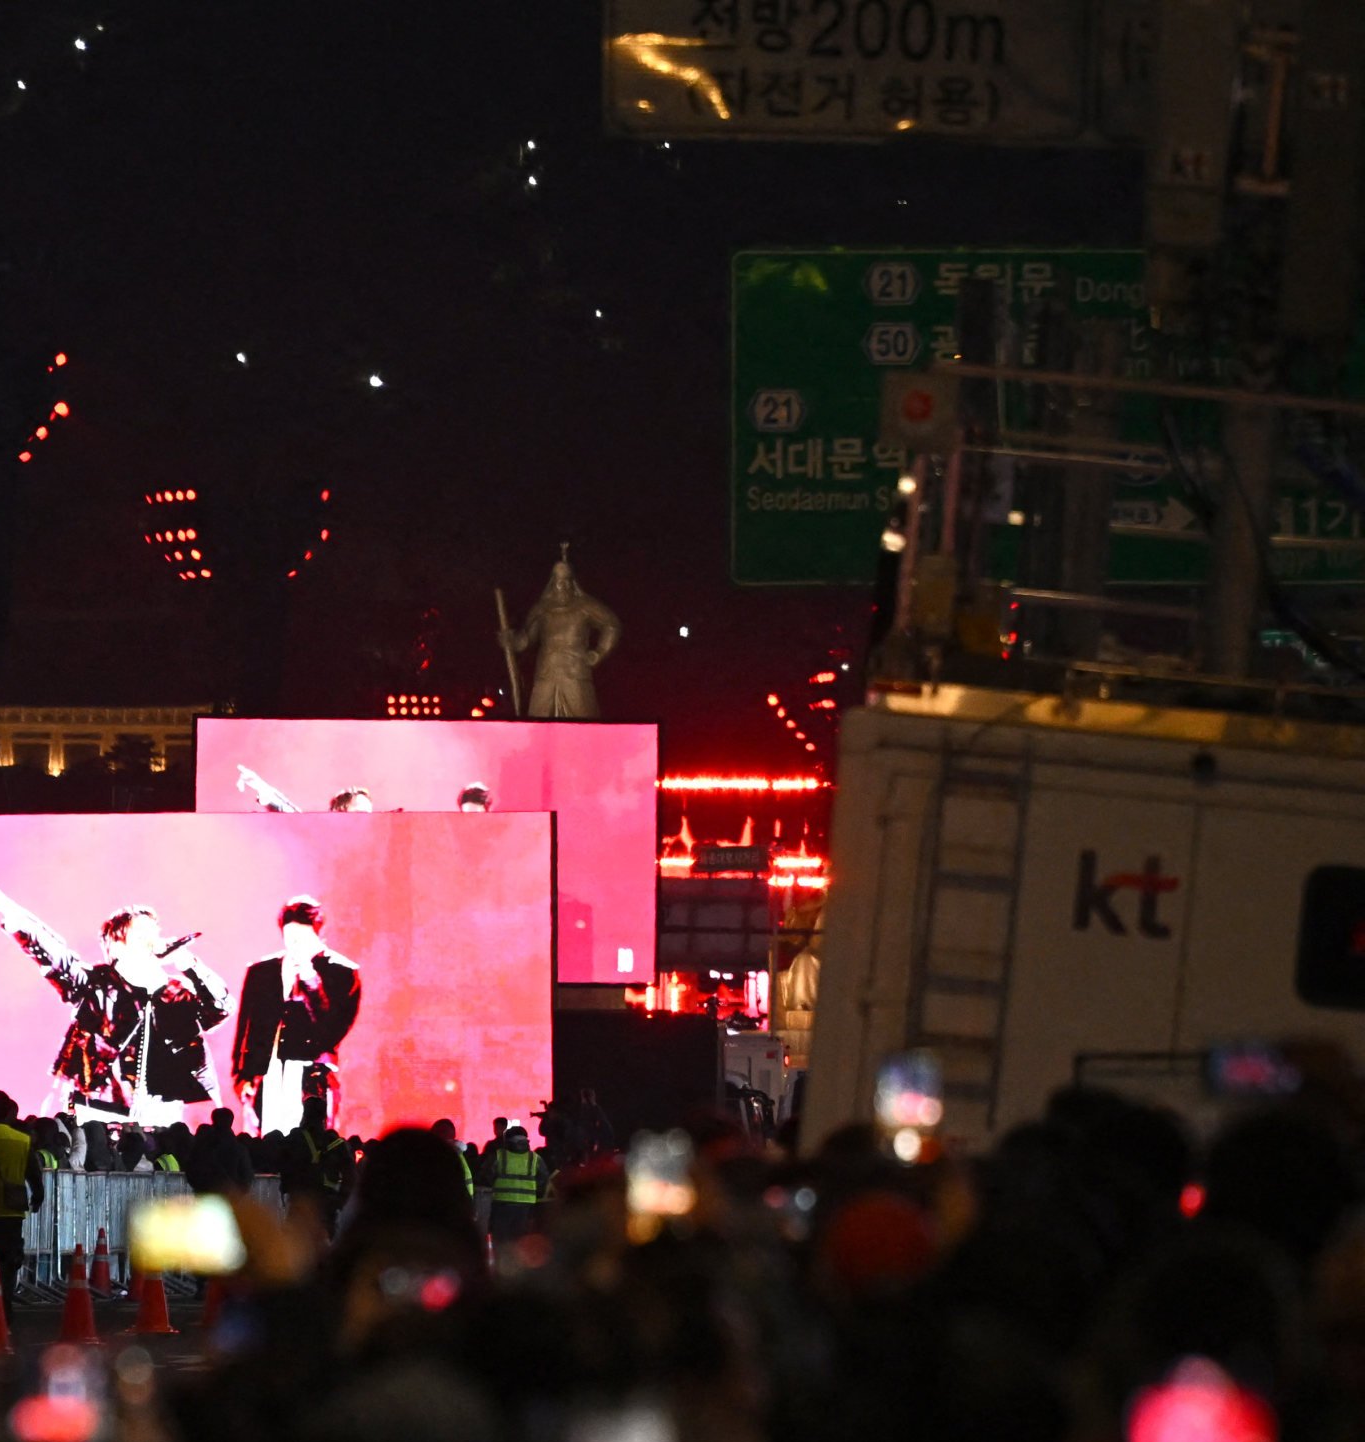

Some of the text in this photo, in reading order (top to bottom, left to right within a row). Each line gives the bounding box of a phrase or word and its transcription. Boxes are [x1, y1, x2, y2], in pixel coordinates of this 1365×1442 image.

[876, 270, 909, 298] 21
[876, 330, 910, 357] 50
[762, 396, 792, 424] 21
[746, 437, 908, 480] 서대문역
[1073, 849, 1180, 940] kt
